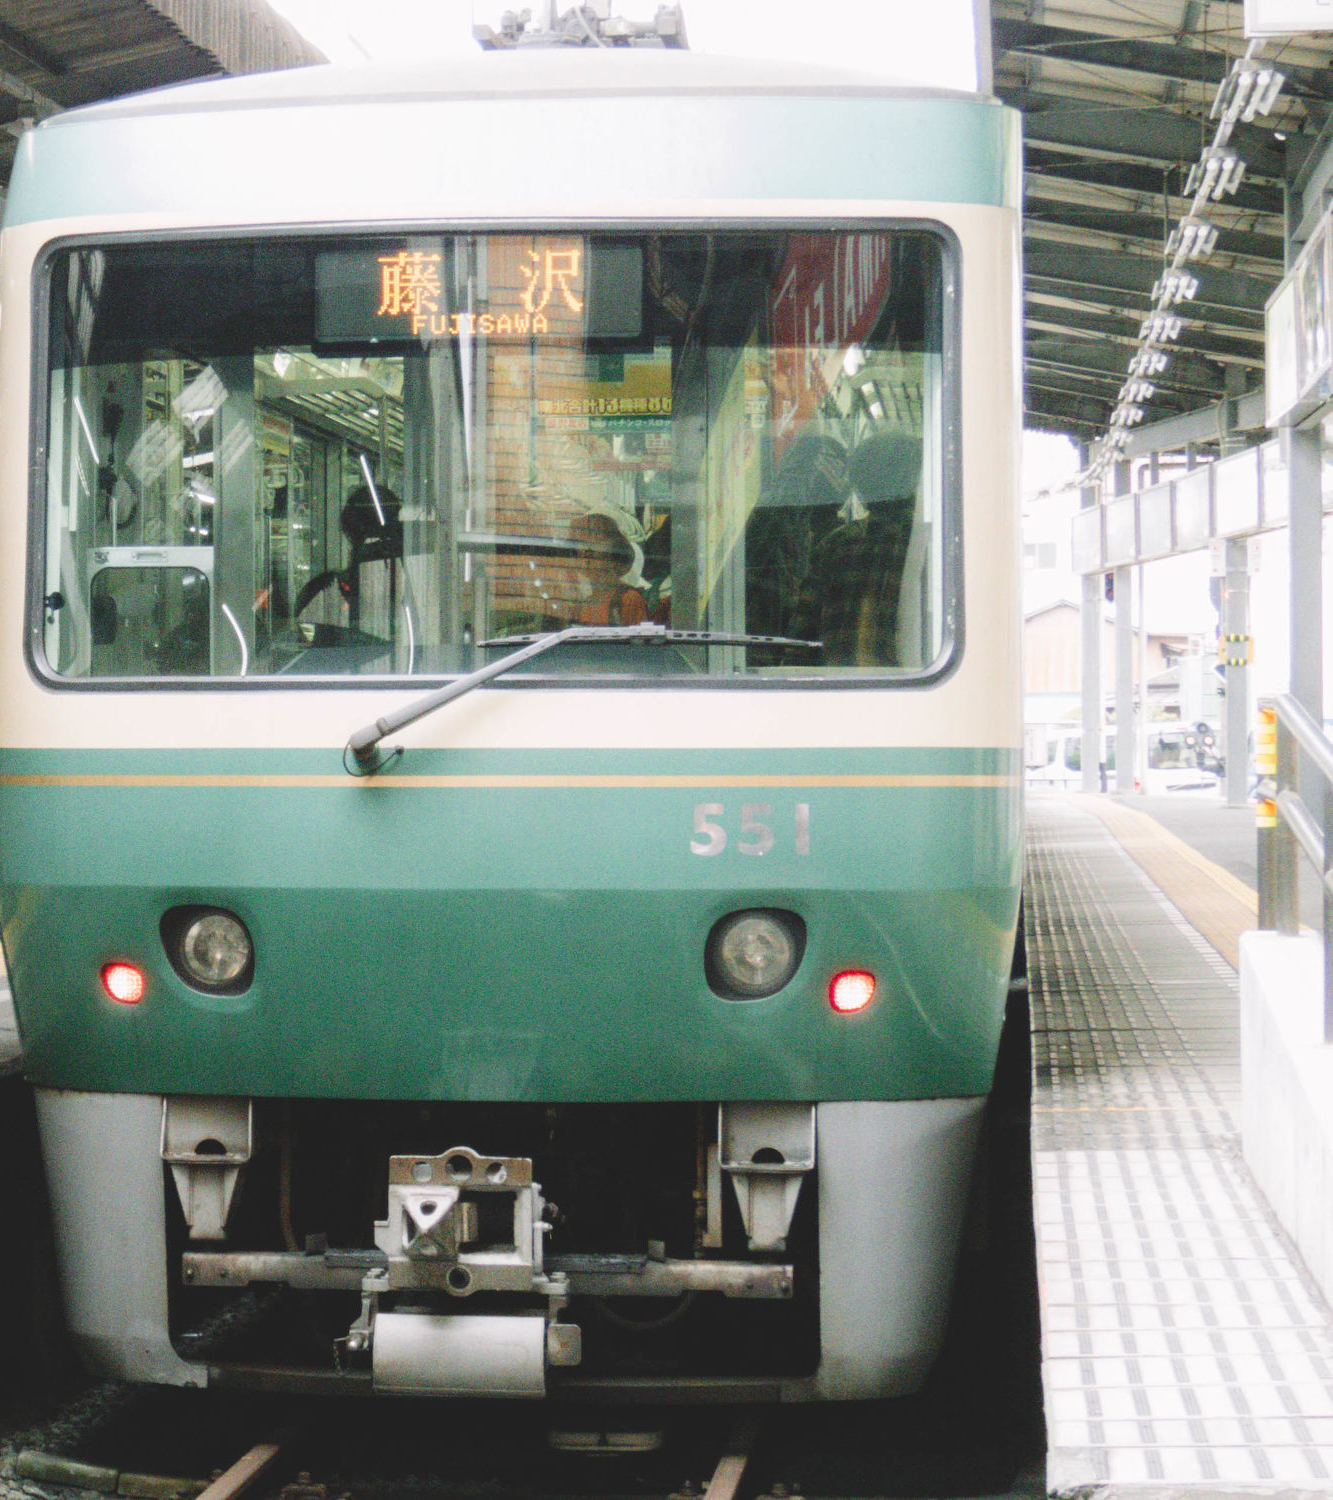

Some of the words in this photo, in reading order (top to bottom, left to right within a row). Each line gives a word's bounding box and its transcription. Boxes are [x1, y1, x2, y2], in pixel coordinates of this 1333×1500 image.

[378, 251, 584, 315] 藤沢
[413, 314, 548, 335] FUJISAWA
[690, 803, 811, 858] 551
